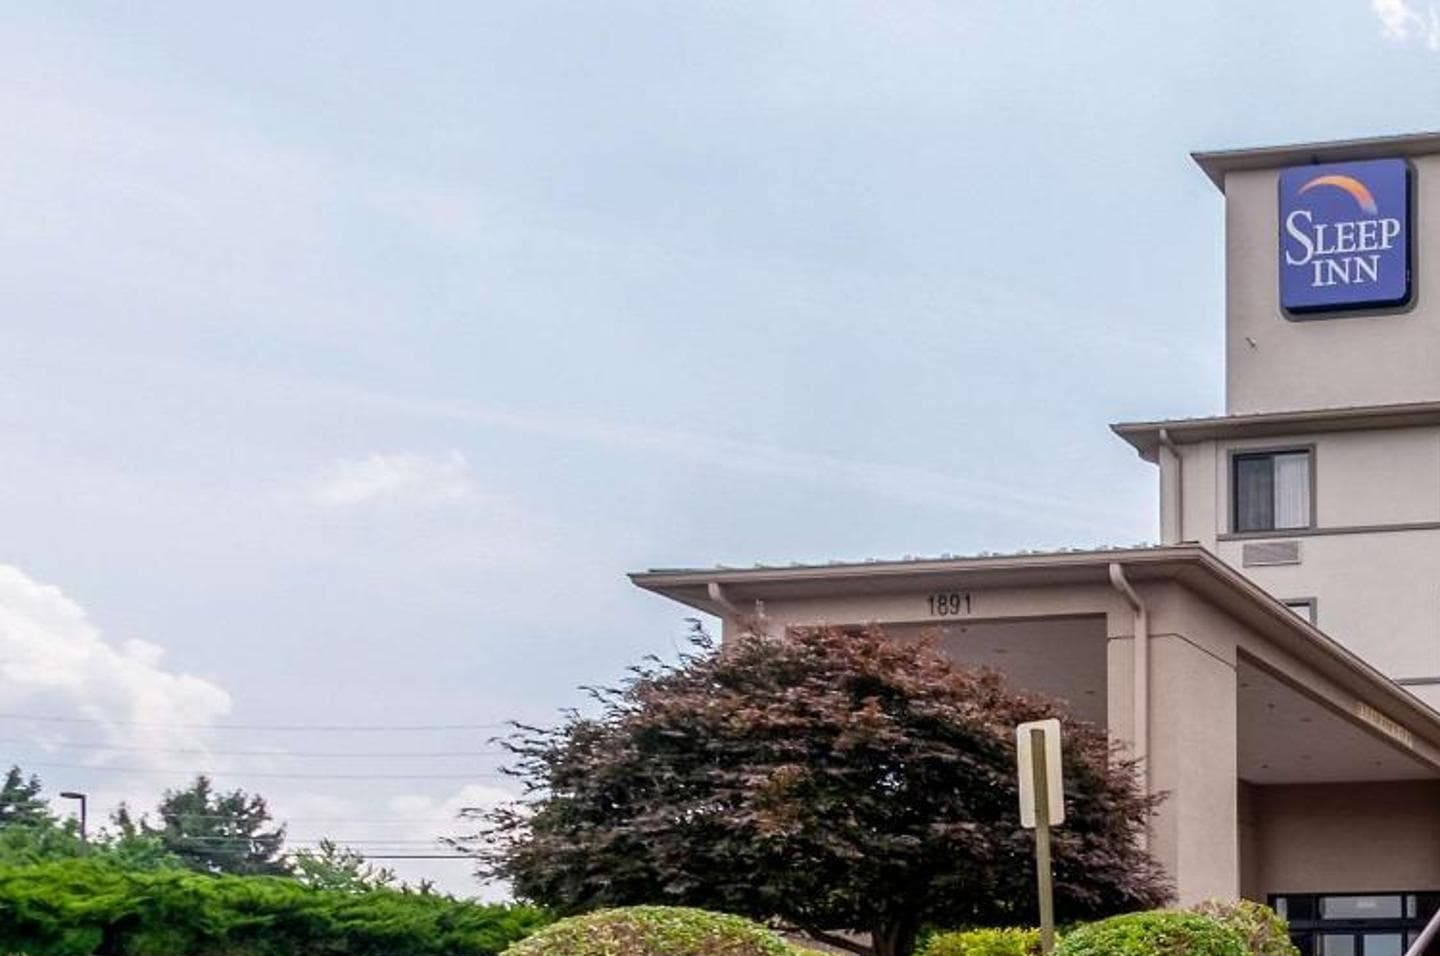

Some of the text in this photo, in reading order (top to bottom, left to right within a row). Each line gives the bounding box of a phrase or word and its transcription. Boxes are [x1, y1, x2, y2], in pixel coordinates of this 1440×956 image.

[1285, 210, 1401, 266] SLEEP
[1311, 254, 1381, 287] INN
[927, 592, 972, 616] 1891
